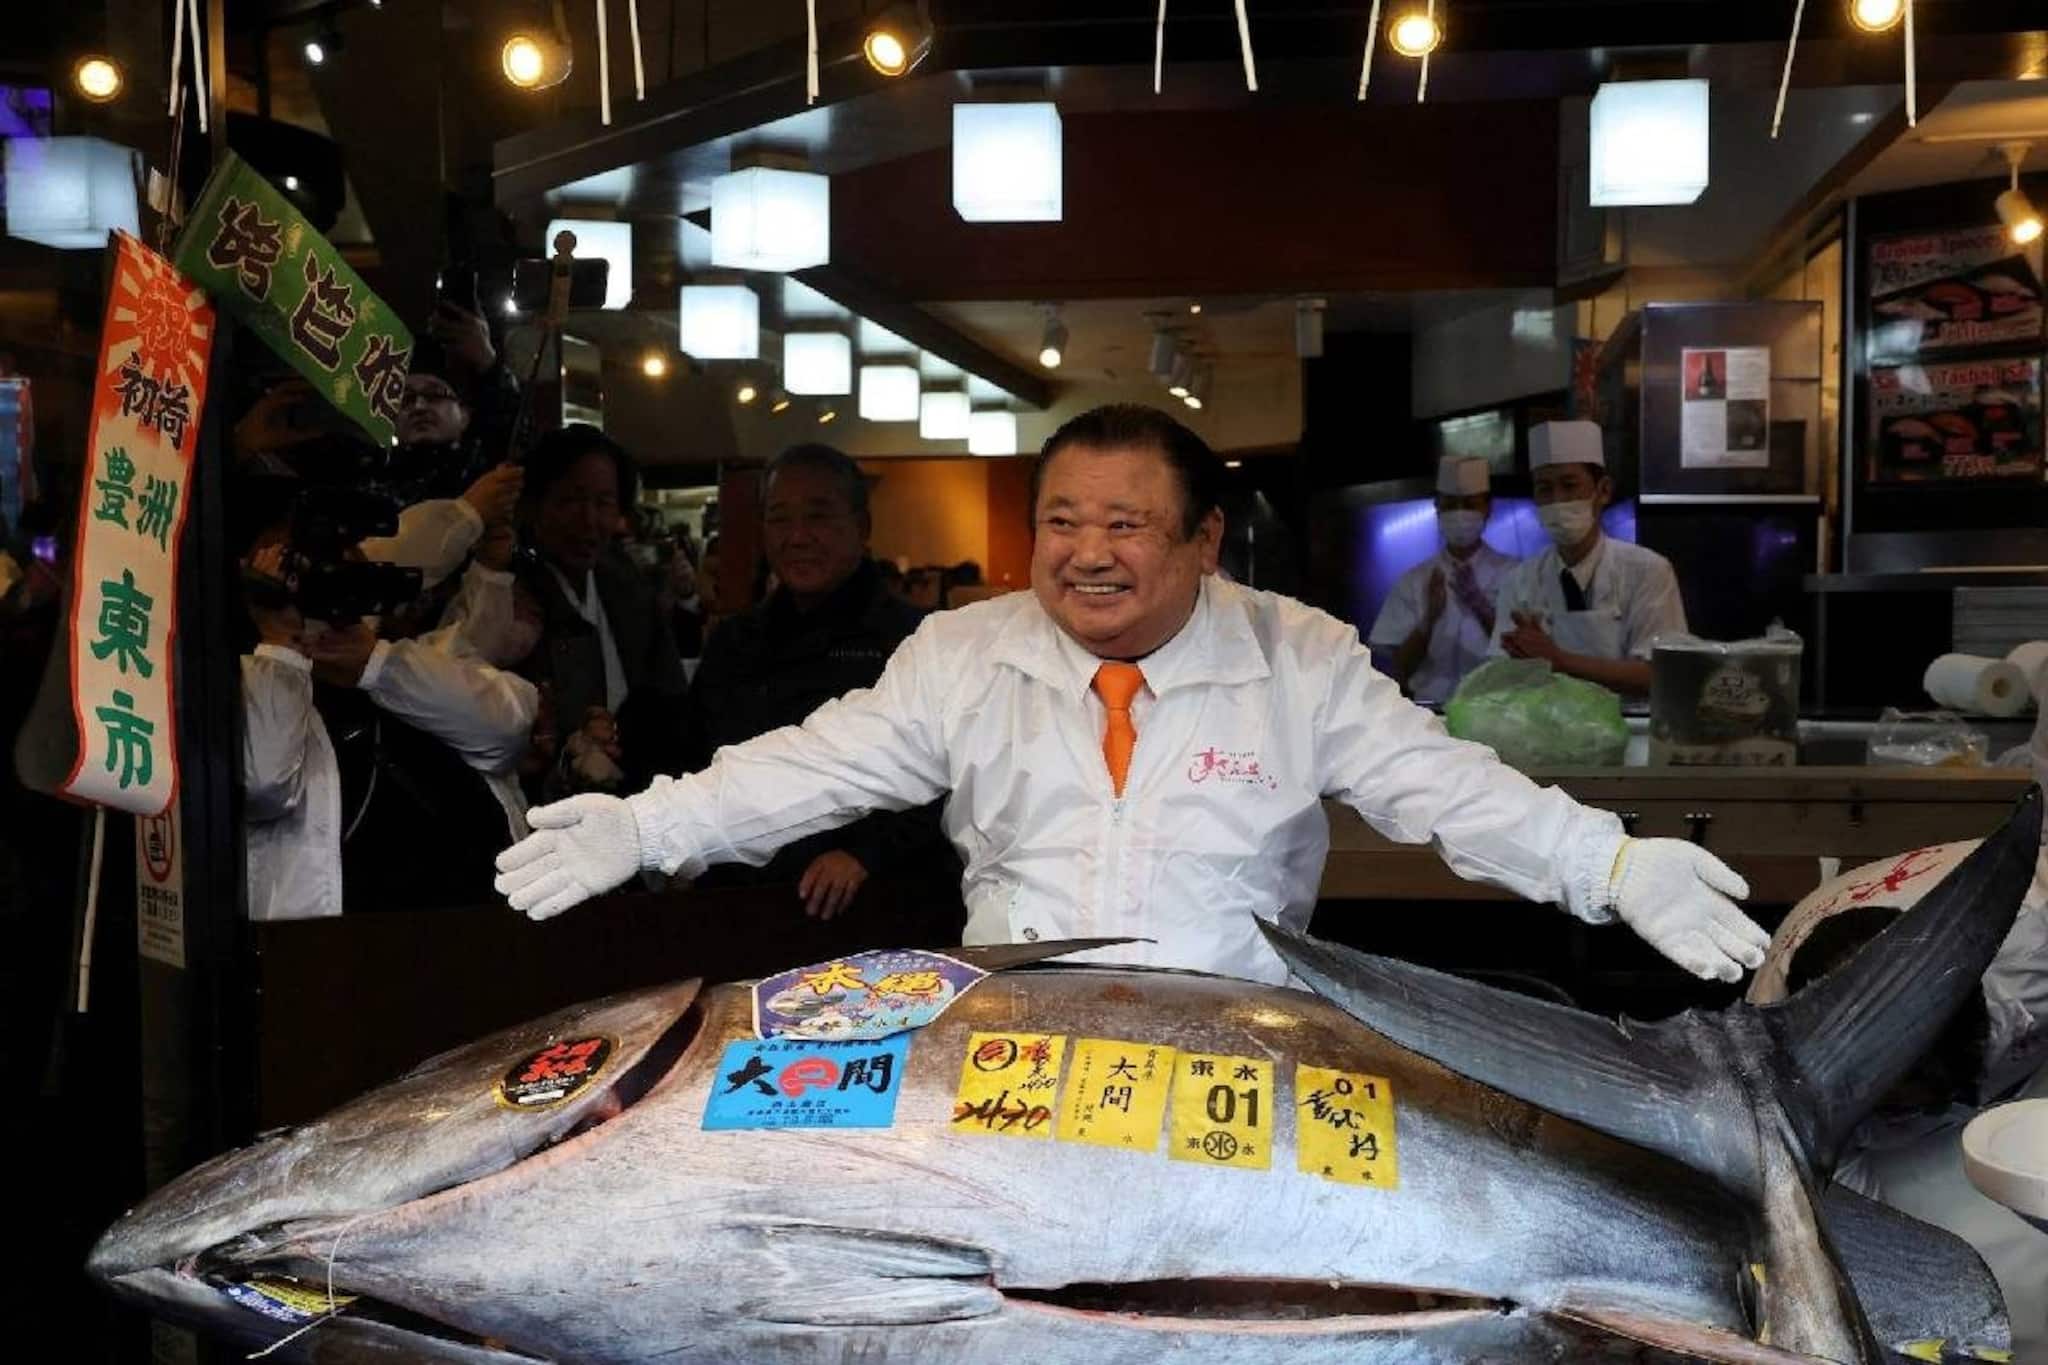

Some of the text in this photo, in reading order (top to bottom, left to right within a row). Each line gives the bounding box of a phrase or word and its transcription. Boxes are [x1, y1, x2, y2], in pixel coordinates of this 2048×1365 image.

[112, 352, 190, 450] 初荷
[95, 445, 179, 553] 豊洲
[1100, 1055, 1139, 1113] 大間
[1206, 1084, 1259, 1128] 01
[1335, 1077, 1377, 1099] 01
